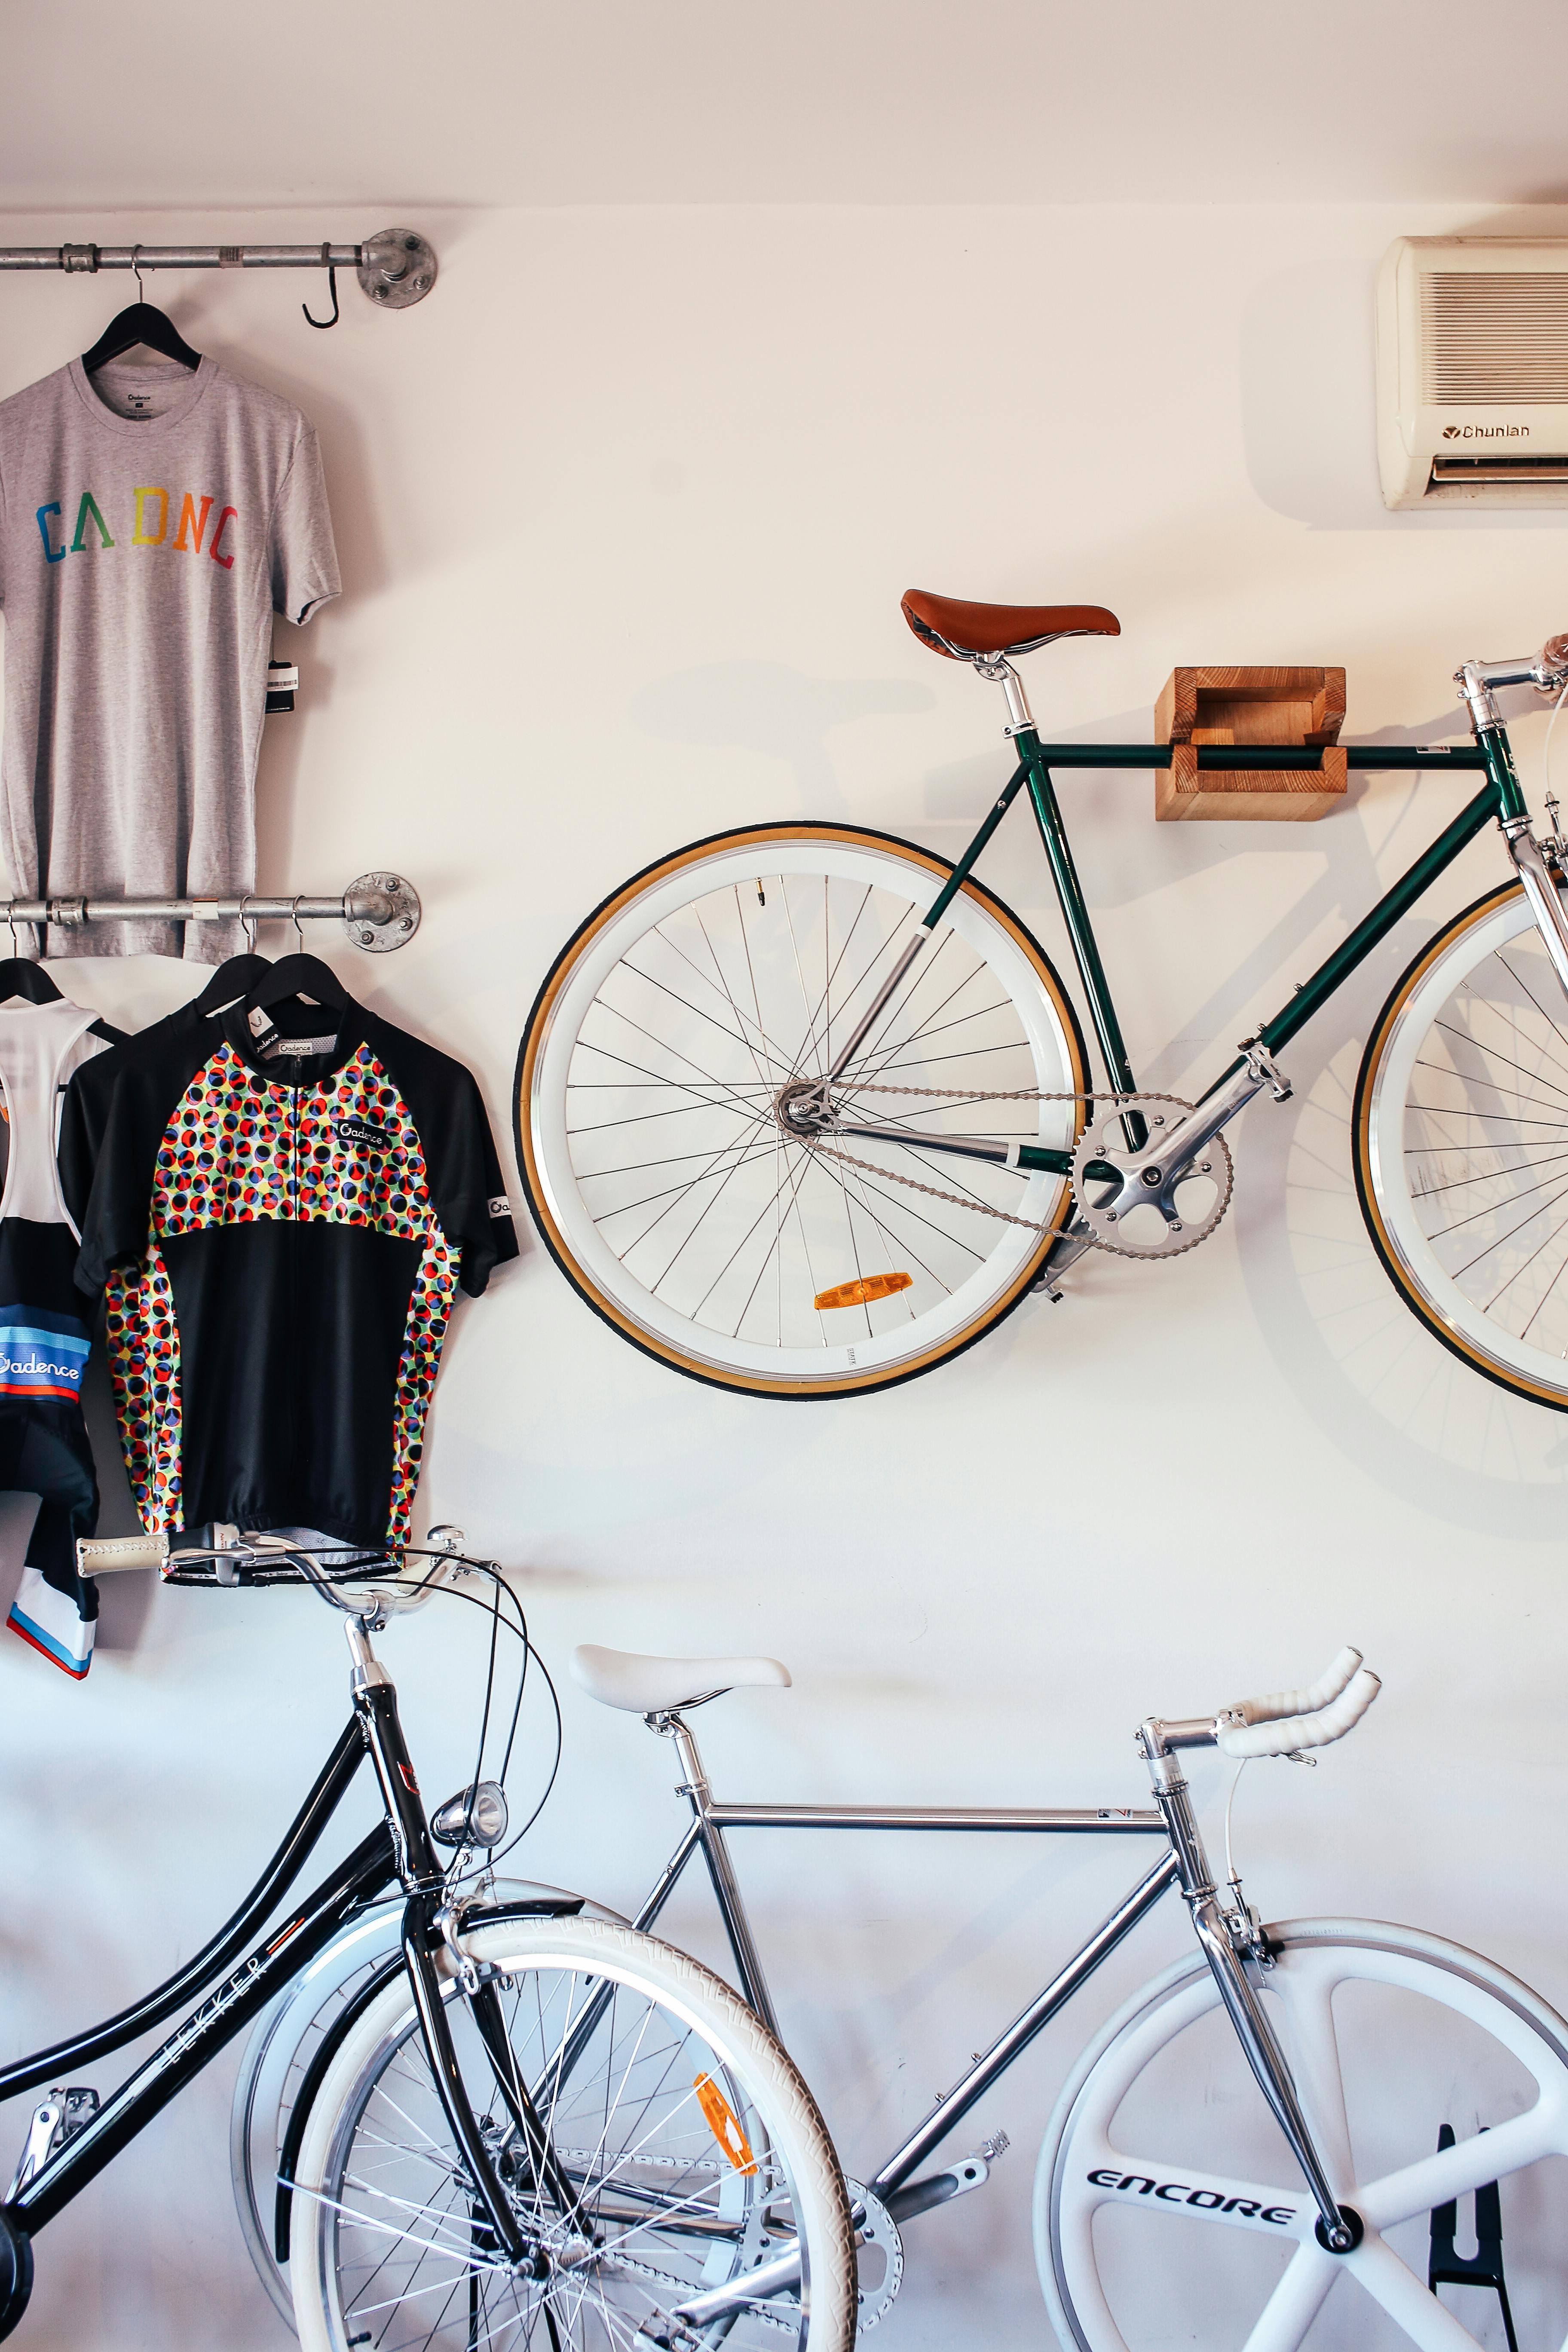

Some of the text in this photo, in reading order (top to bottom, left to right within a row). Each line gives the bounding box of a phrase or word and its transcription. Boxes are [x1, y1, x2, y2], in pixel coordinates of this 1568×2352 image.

[1462, 423, 1529, 438] Chunlan
[257, 1034, 279, 1053] adence
[340, 1123, 382, 1144] Cadence
[1087, 2169, 1297, 2225] ENCORE
